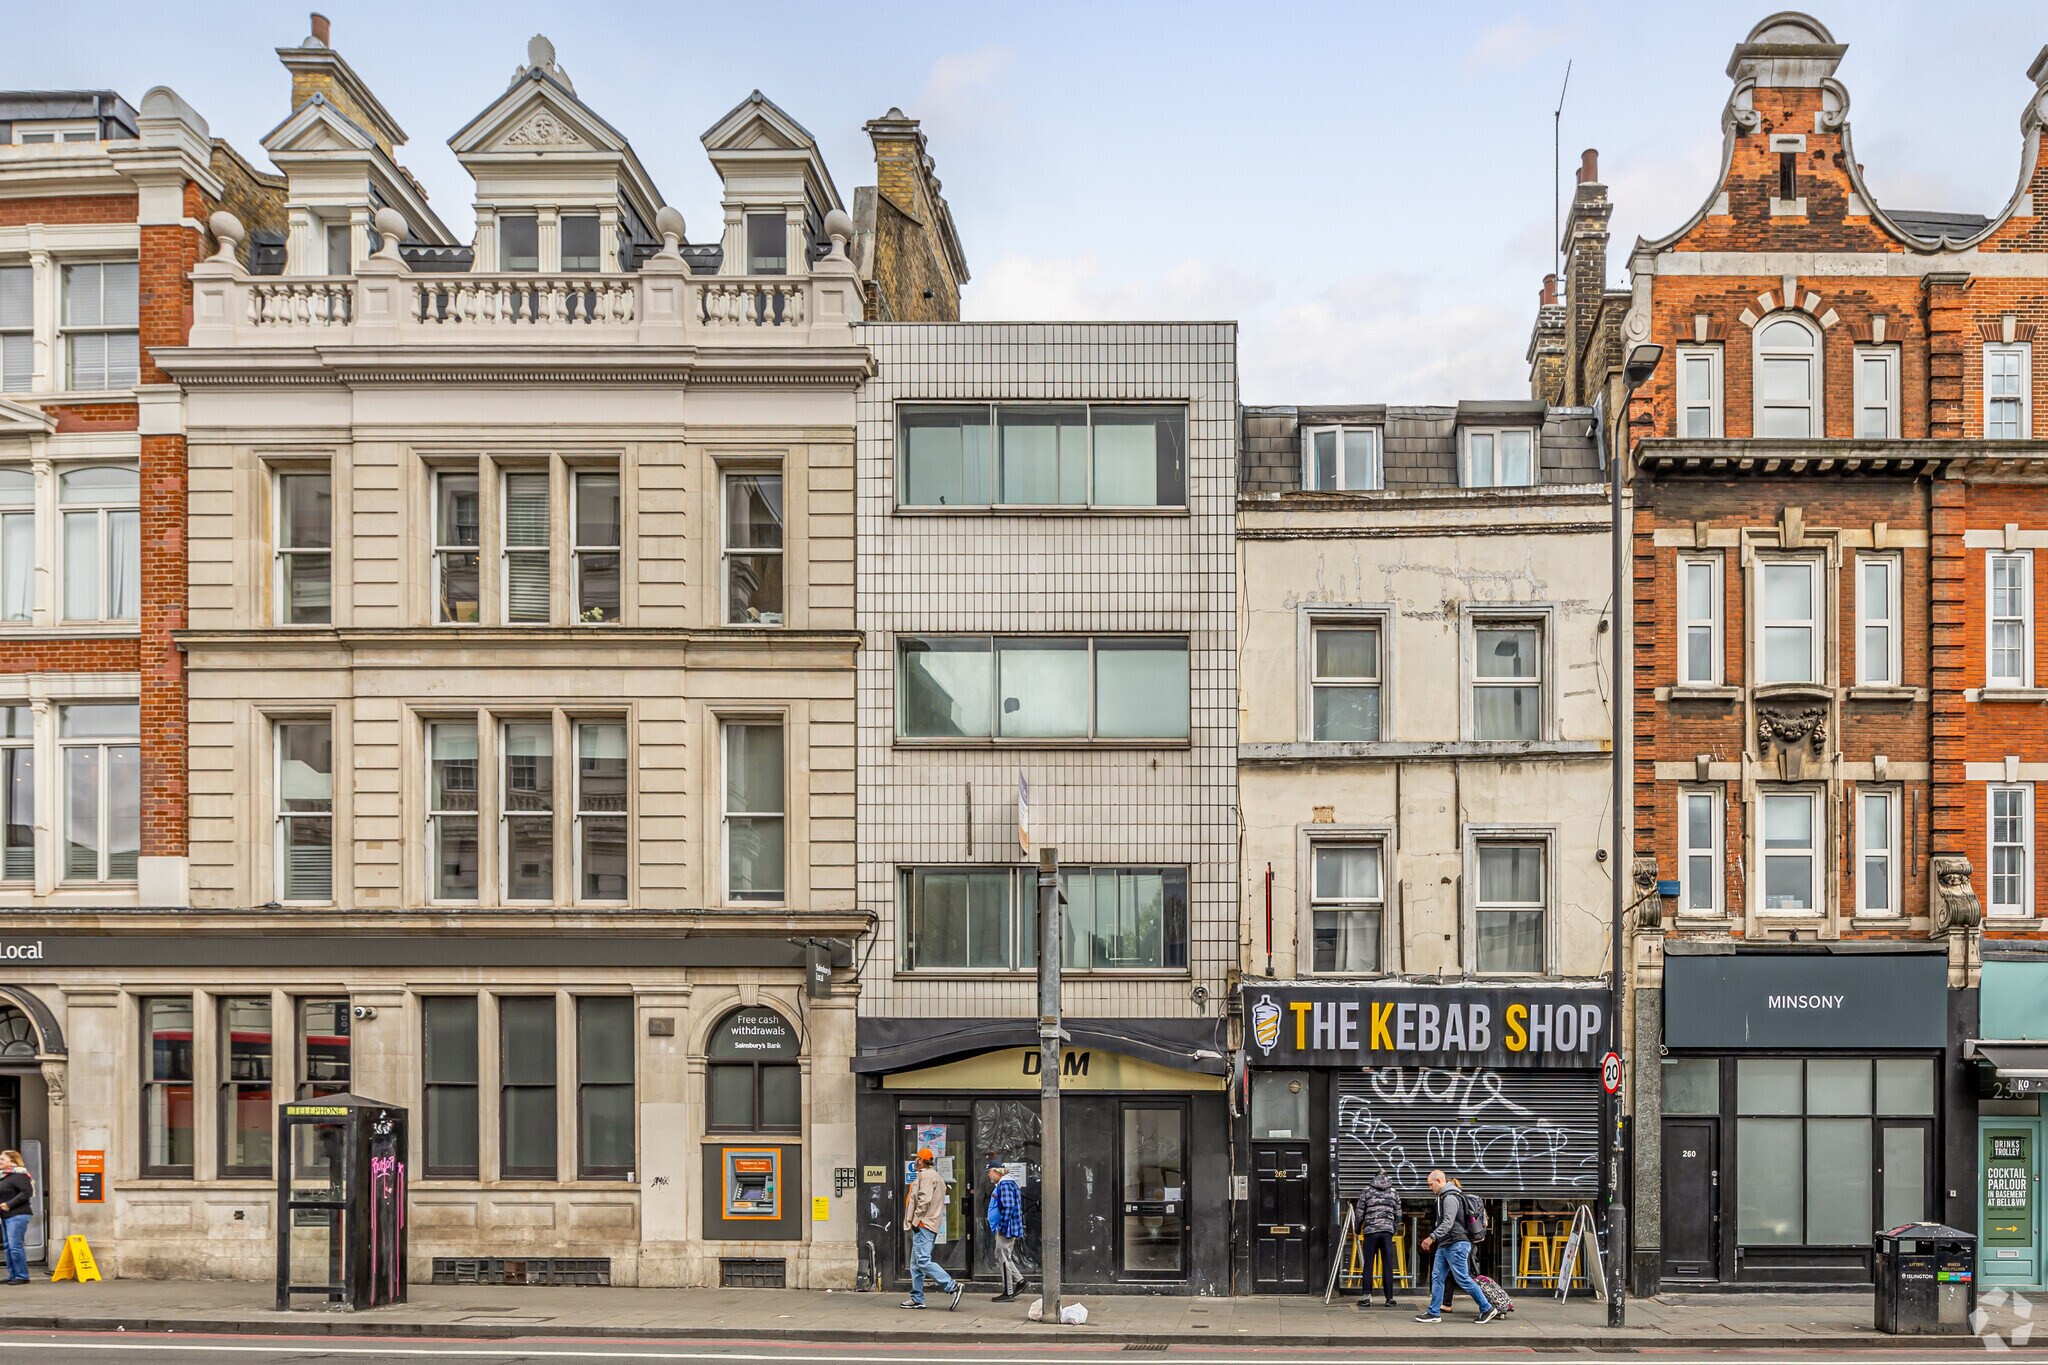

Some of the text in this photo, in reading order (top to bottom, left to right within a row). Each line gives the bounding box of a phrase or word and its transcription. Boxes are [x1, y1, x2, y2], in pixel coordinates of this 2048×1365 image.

[1768, 995, 1844, 1009] MINSONY
[737, 1015, 779, 1024] Free cash
[731, 1026, 785, 1035] withdrawals
[1290, 1002, 1602, 1053] THE KEBAB SHOP
[735, 1042, 766, 1050] Sainsbury's
[1023, 1051, 1091, 1076] DM
[1605, 1064, 1618, 1081] 20
[294, 1106, 343, 1115] TELEPHONE
[1994, 1140, 2020, 1148] DRINKS
[1682, 1150, 1696, 1158] 260
[1994, 1148, 2020, 1156] TROLLEY
[1274, 1169, 1287, 1178] 262
[1987, 1168, 2027, 1179] COCKTAIL
[1987, 1179, 2027, 1190] PARLOUR
[1987, 1190, 2026, 1198] IN BASEMENT
[1987, 1198, 2026, 1207] AT BELL&VIV
